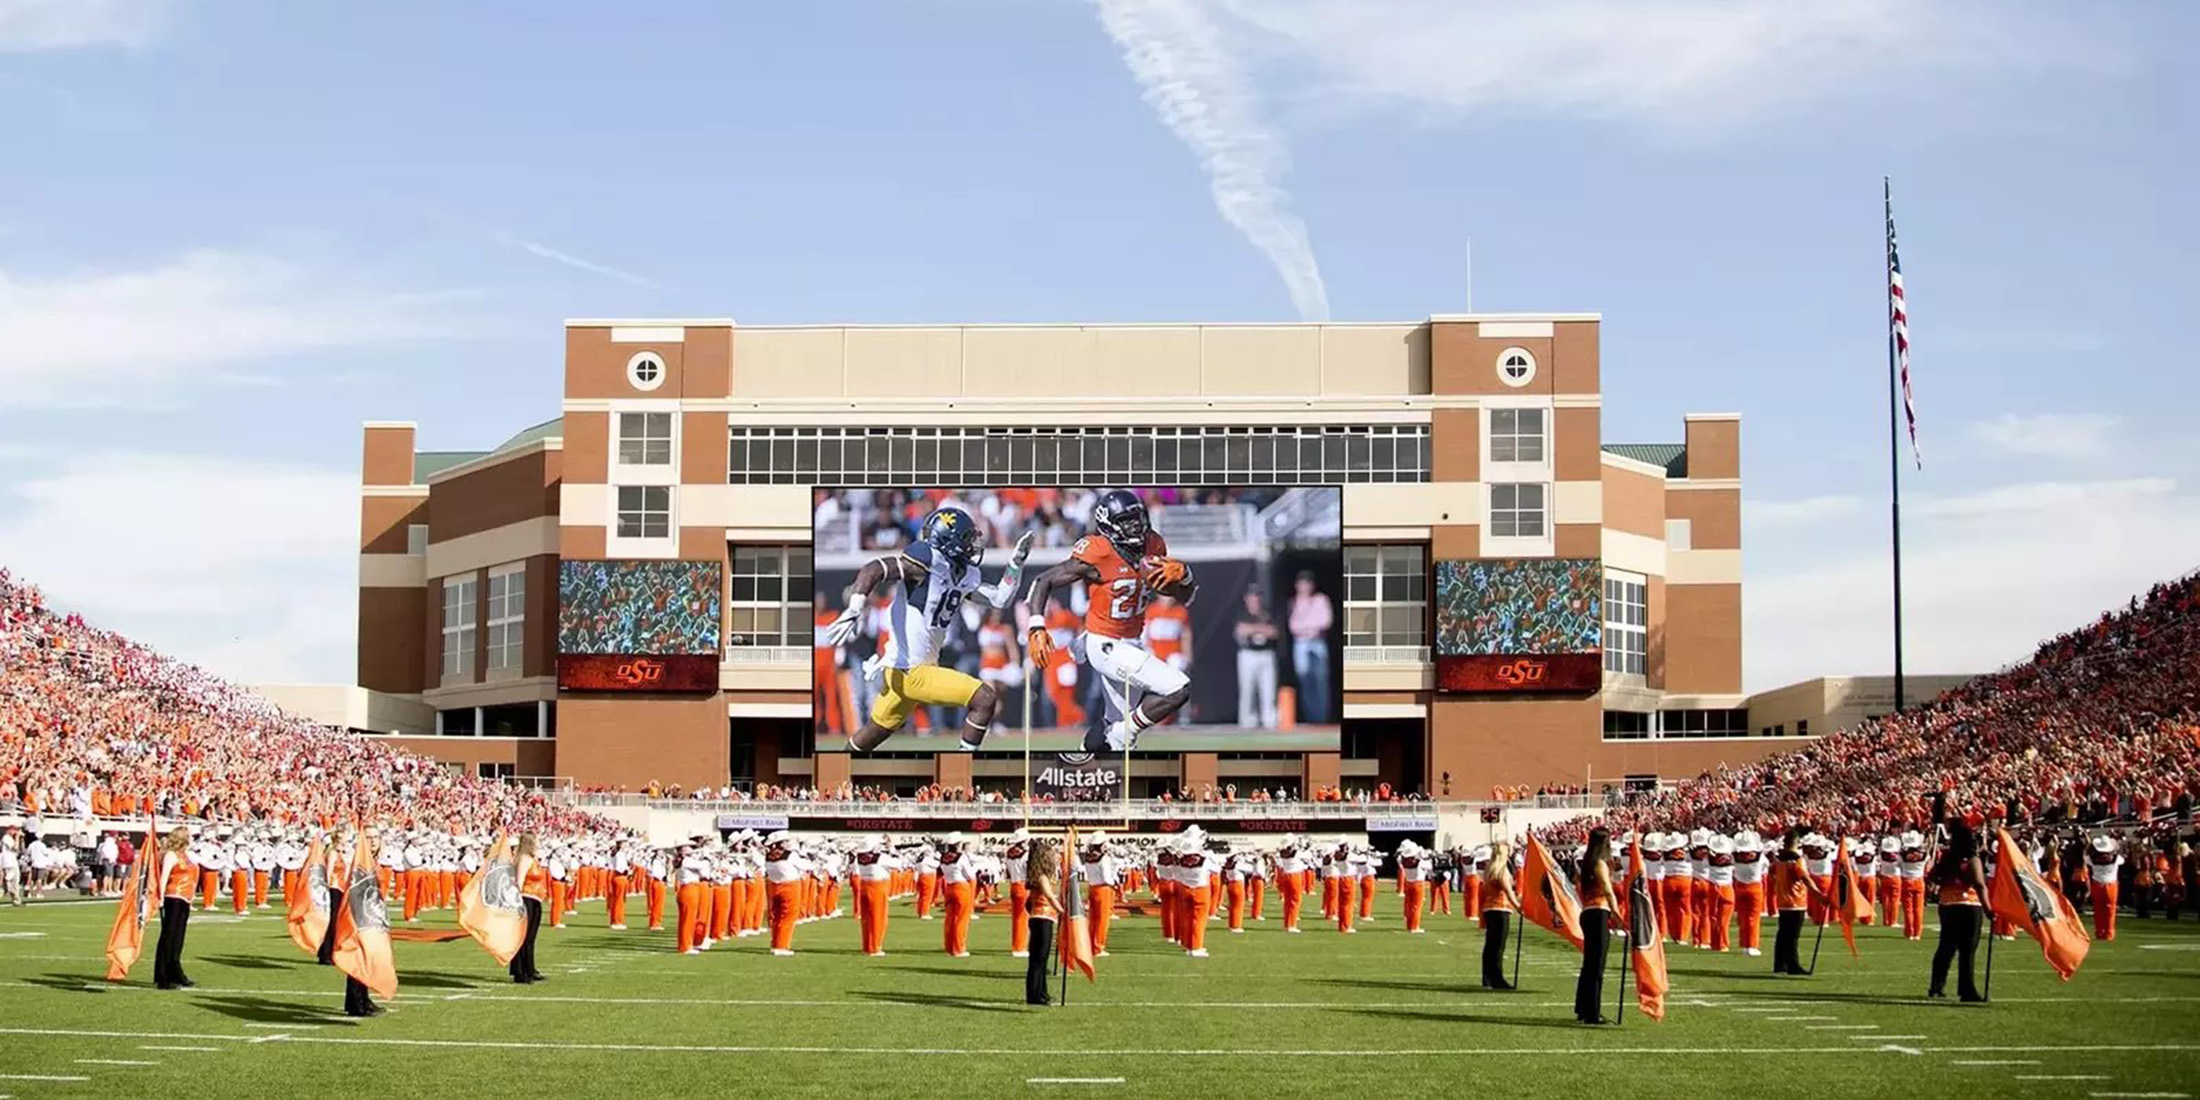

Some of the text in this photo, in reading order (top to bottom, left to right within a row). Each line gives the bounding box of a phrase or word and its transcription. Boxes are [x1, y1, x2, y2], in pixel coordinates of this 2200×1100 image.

[930, 588, 962, 628] 19
[616, 659, 665, 684] OSU
[1497, 659, 1546, 685] OSU
[1482, 809, 1498, 822] 25
